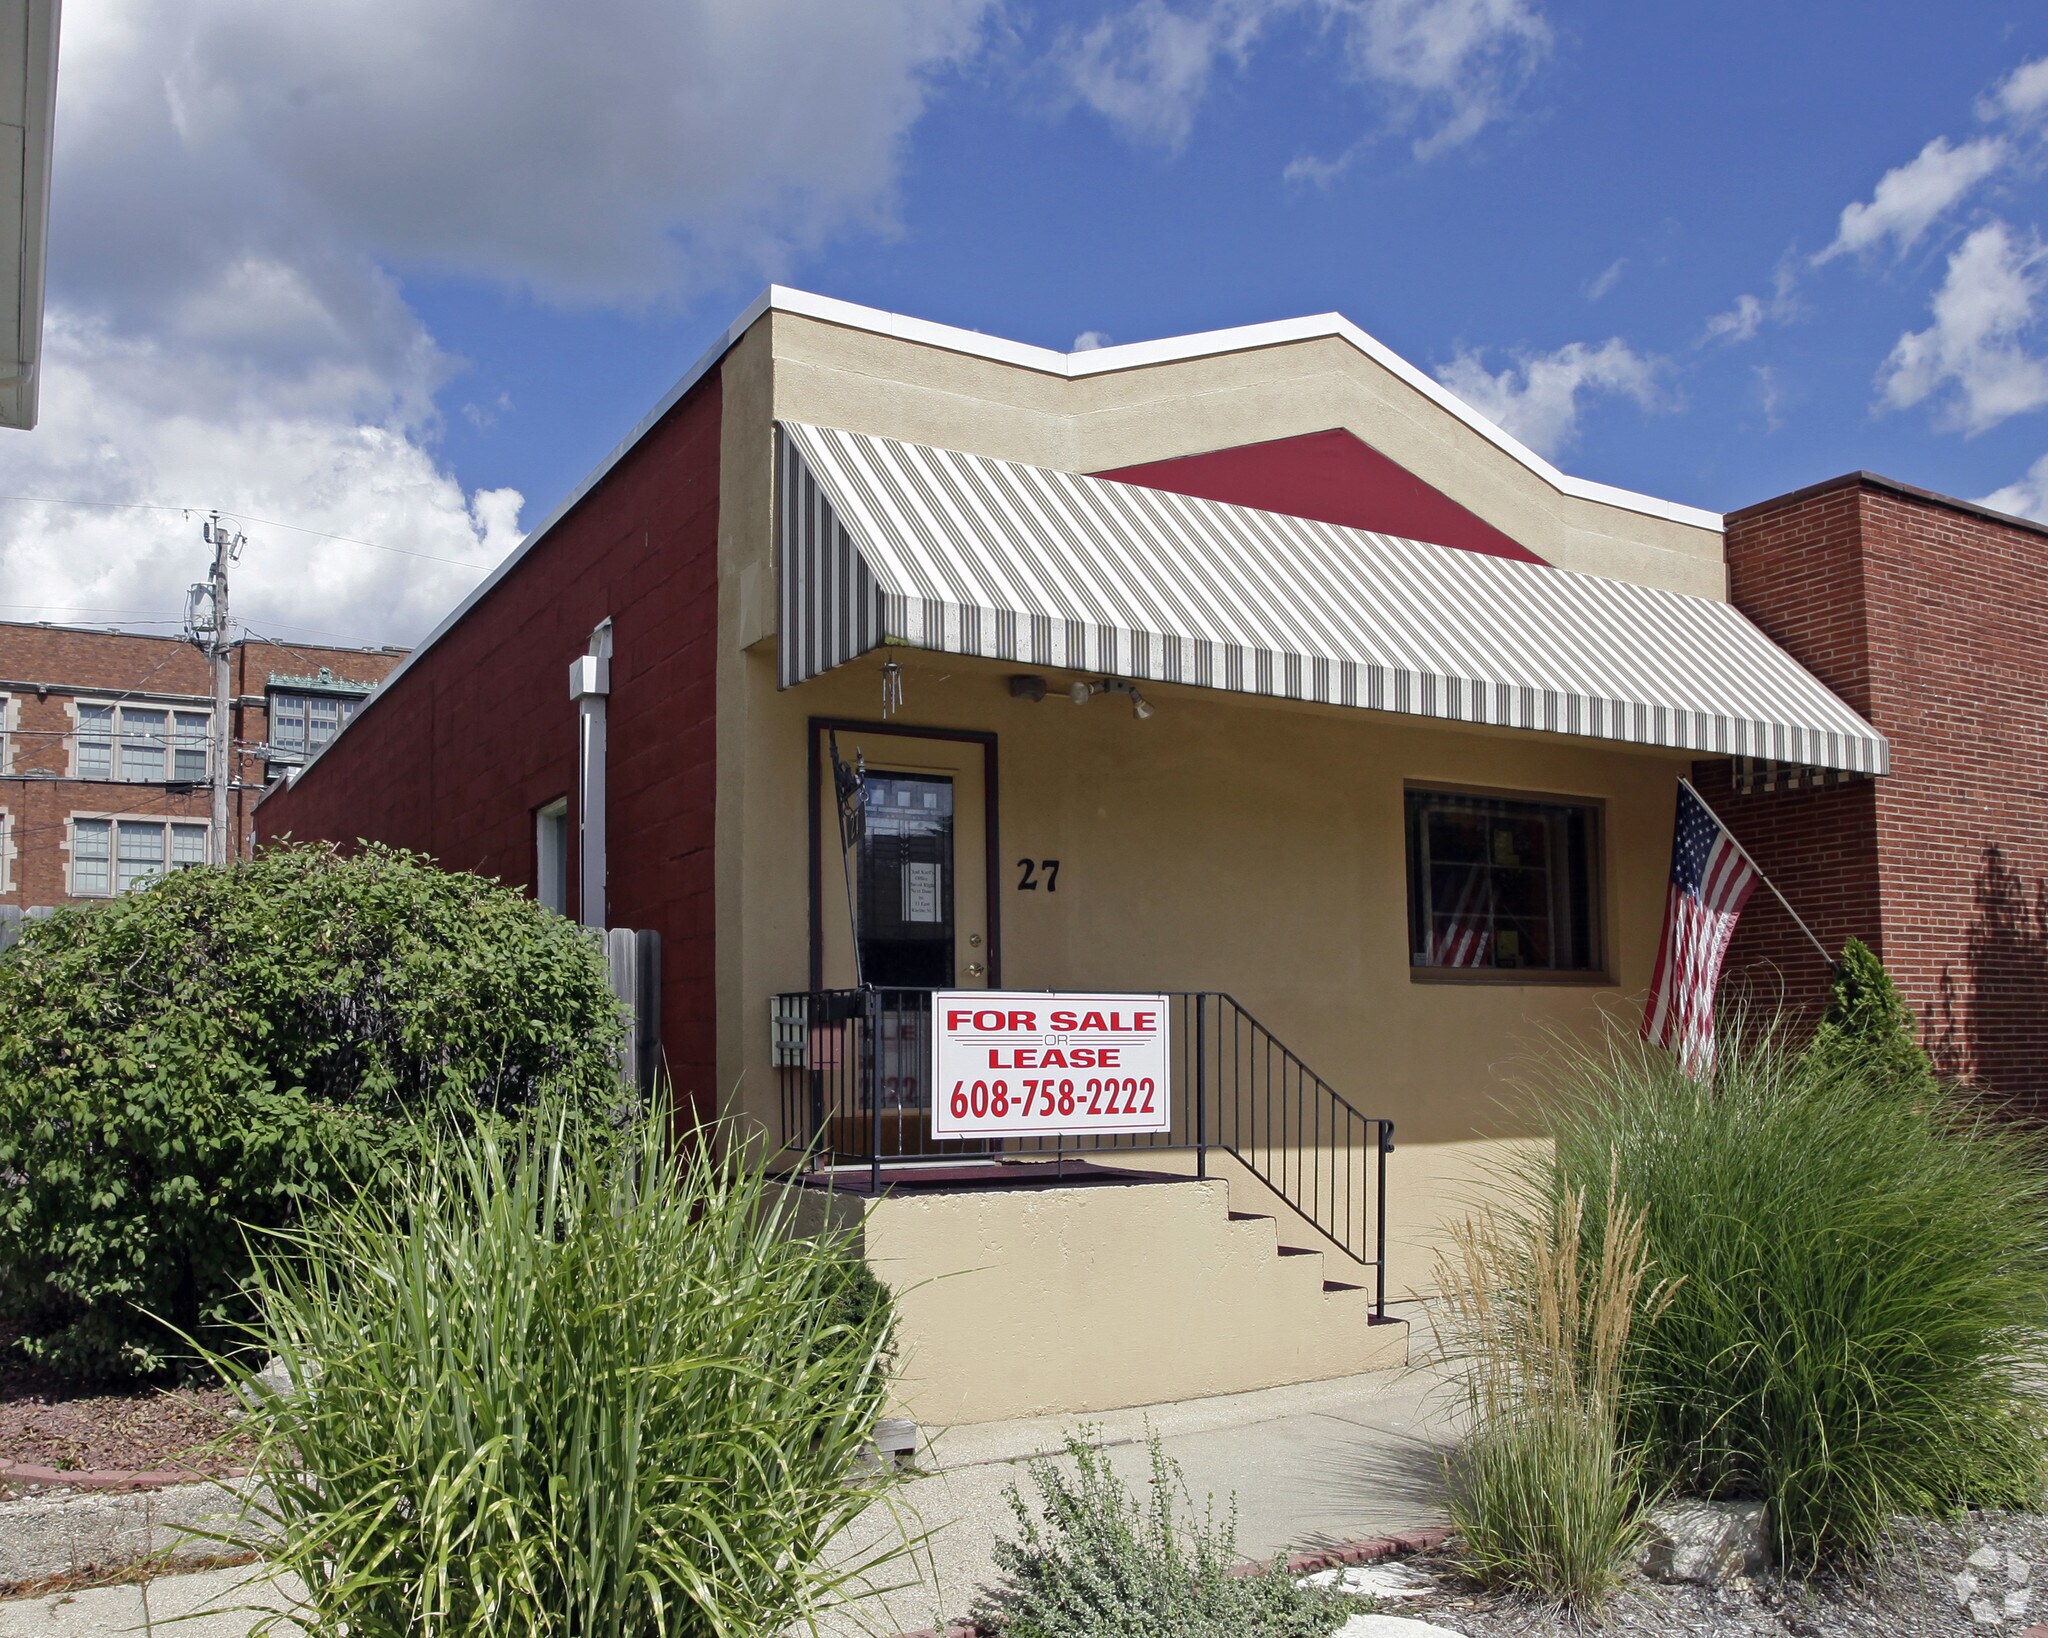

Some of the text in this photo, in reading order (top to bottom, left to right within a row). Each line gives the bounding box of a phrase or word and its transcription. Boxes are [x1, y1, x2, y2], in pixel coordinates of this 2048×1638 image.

[1017, 858, 1060, 892] 27
[947, 1010, 1157, 1031] FOR SALE
[1044, 1034, 1068, 1046] OR
[988, 1048, 1121, 1069] LEASE
[950, 1077, 1155, 1119] 608-758-2222
